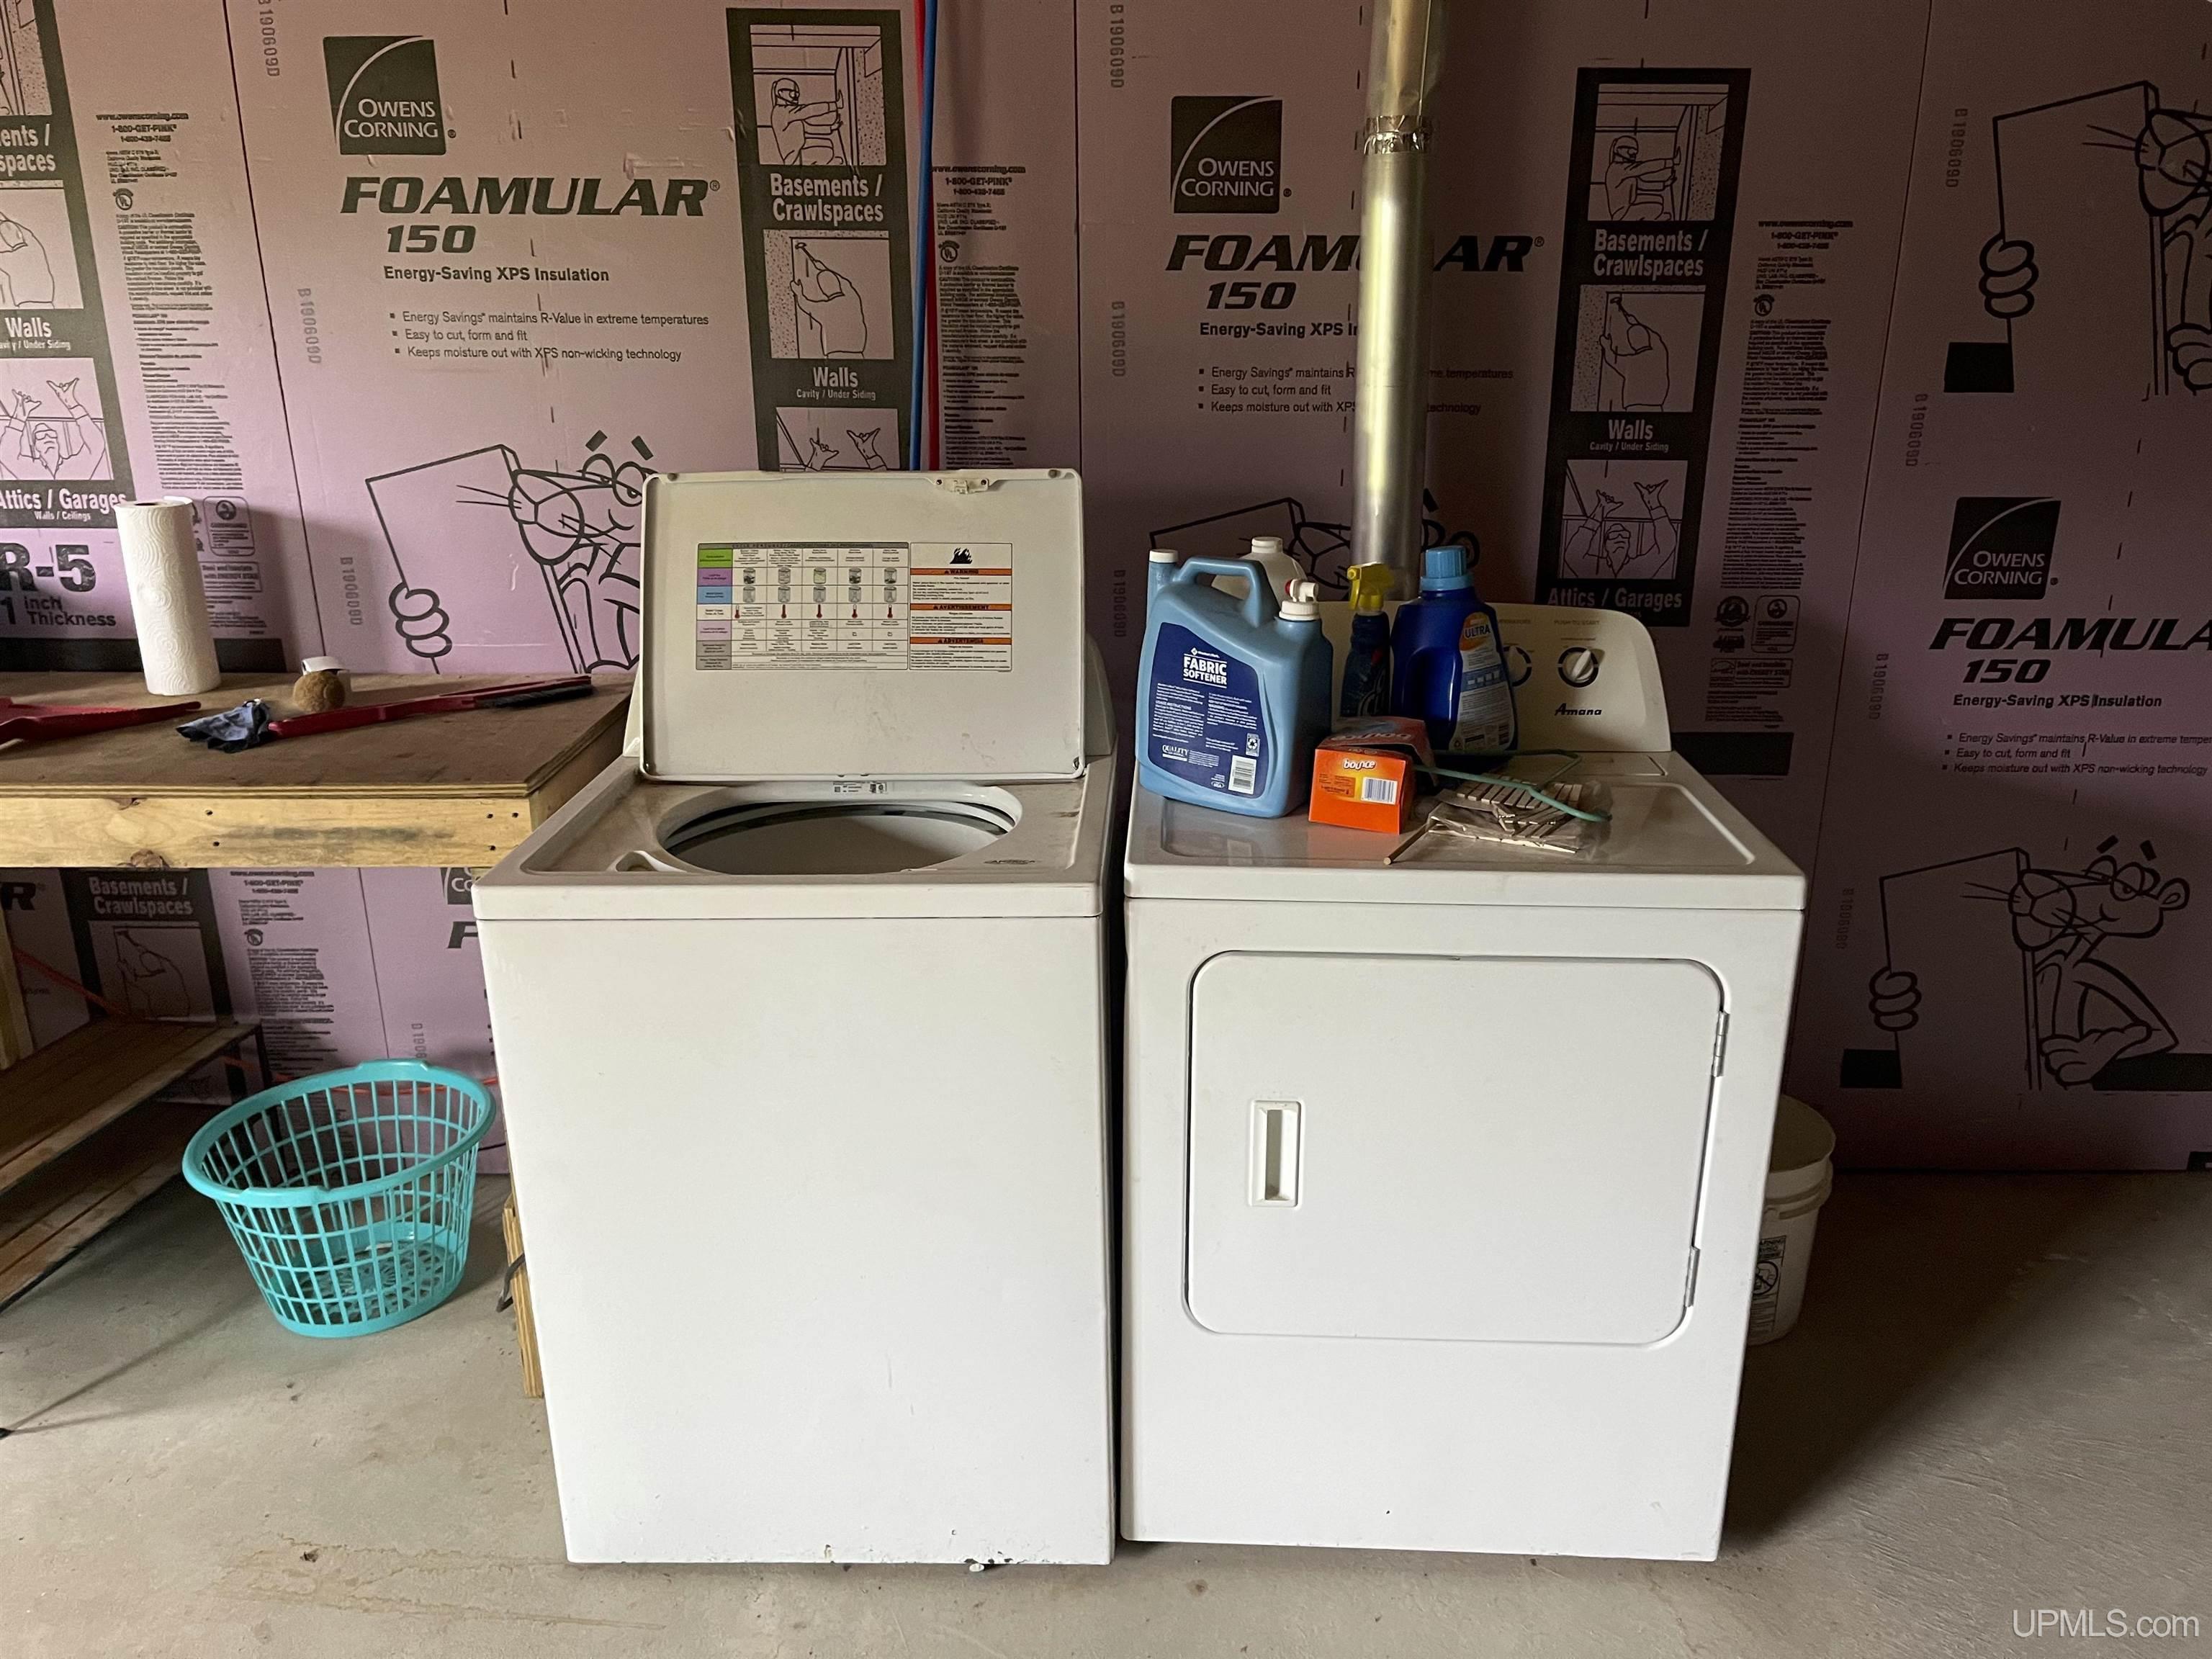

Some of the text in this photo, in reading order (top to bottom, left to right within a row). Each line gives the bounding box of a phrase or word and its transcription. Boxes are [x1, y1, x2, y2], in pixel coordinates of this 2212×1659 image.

[358, 98, 436, 118] OWENS
[0, 125, 39, 146] ents
[343, 119, 439, 138] CORNING
[1197, 157, 1274, 177] OWENS
[770, 173, 869, 197] Basements
[1180, 178, 1274, 197] CORNING
[773, 197, 884, 227] Crawlspaces
[387, 224, 477, 254] 150
[1594, 228, 1694, 252] Basements
[384, 266, 610, 283] Energy-Saving XPS Insulation
[1593, 253, 1704, 282] Crawlspaces
[1206, 282, 1297, 310] 150
[4, 317, 53, 338] Walls
[403, 310, 439, 325] Energy
[488, 313, 538, 324] maintains
[541, 312, 581, 324] R-Value
[584, 313, 593, 323] in
[596, 313, 638, 325] extreme
[641, 314, 709, 328] temperatures
[405, 328, 528, 343] Easy to cut, form and fit
[1200, 322, 1344, 338] Energy-Saving XPS
[408, 346, 682, 362] Keeps moisture out with XPS non-wicking technology
[813, 367, 859, 388] Walls
[1211, 367, 1248, 381] Energy
[1295, 367, 1344, 378] maintains
[796, 389, 819, 400] Cavity
[827, 389, 850, 398] Under
[1211, 384, 1331, 397] Easy to cut, form and fit
[1211, 401, 1244, 414] Keeps
[1246, 402, 1290, 413] moisture
[1293, 402, 1309, 413] out
[1312, 401, 1333, 413] with
[1608, 419, 1654, 441] Walls
[0, 542, 97, 593] R-5
[1972, 549, 2046, 568] OWENS
[1954, 568, 2044, 585] CORNING
[24, 596, 63, 611] inch
[1547, 587, 1596, 606] Attics
[1614, 587, 1683, 612] Garages
[27, 611, 117, 626] Thickness
[1465, 624, 1491, 638] ULTRA
[1183, 656, 1227, 676] FABRIC
[1963, 659, 2051, 683] 150
[1183, 668, 1227, 685] SOFTENER
[1554, 702, 1602, 716] Amana
[1953, 694, 2162, 709] Energy-Saving XPS Insulation
[1959, 733, 1993, 745] Energy
[2038, 734, 2086, 743] maintains
[2087, 734, 2125, 743] R-Value
[2128, 734, 2136, 743] in
[2139, 735, 2177, 744] extreme
[1162, 745, 1189, 756] QUALITY
[1956, 747, 2070, 760] Easy to cut, form and fit
[1343, 759, 1377, 770] bounce
[1954, 763, 2208, 776] Keeps moisture out with XPS non-wicking technology
[89, 876, 178, 896] Basements
[93, 896, 194, 918] Crawlspaces
